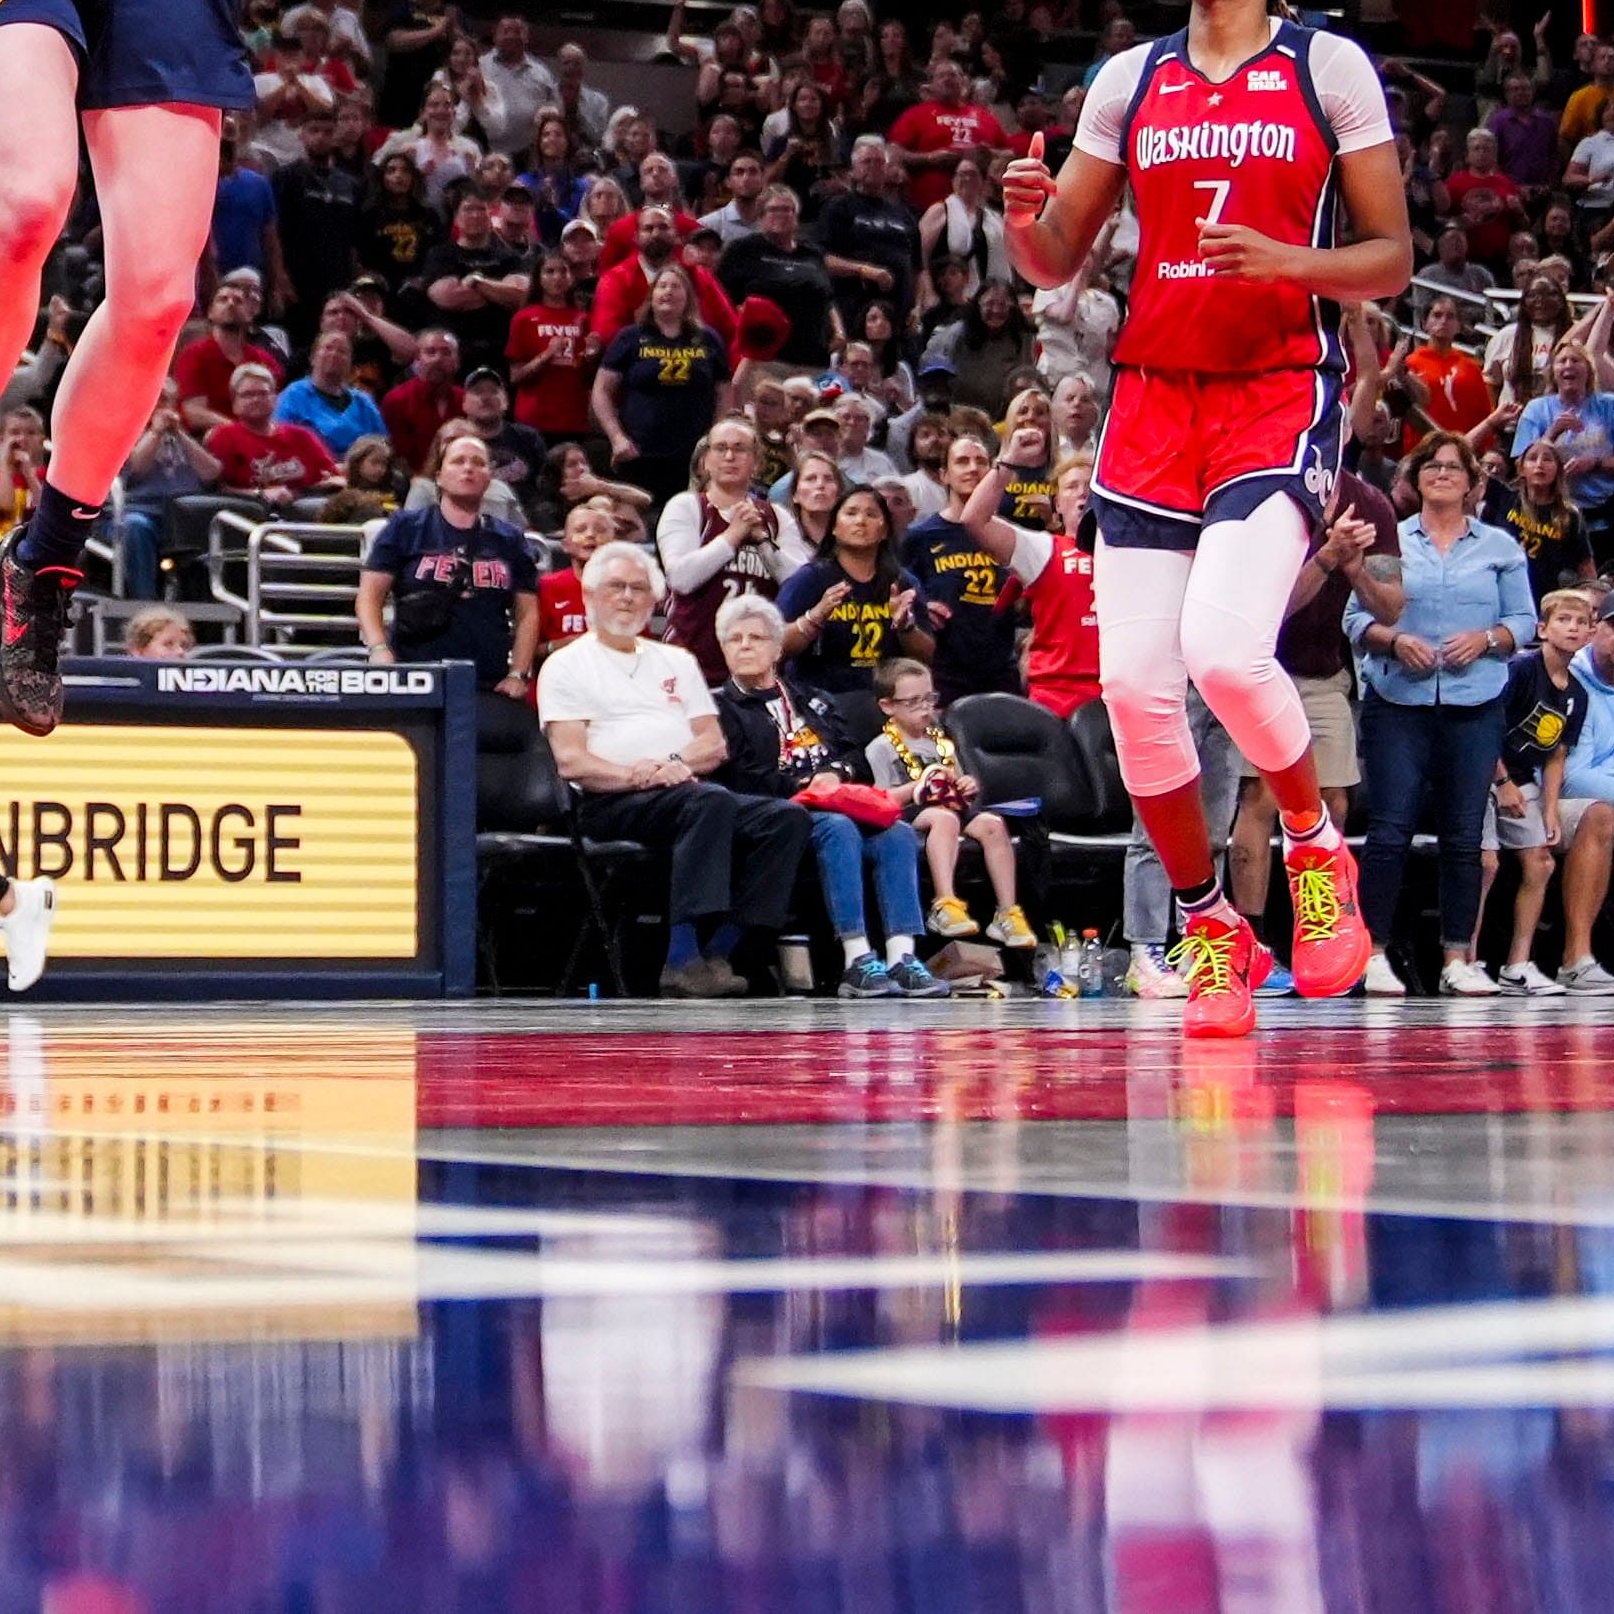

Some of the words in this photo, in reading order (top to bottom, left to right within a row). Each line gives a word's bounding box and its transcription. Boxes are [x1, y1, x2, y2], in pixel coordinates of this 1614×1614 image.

[1136, 121, 1296, 171] Washington
[1193, 180, 1231, 226] 7
[638, 345, 707, 360] INDIANA
[657, 359, 692, 383] 22
[416, 553, 510, 590] FEER
[963, 571, 995, 595] 22
[850, 621, 882, 659] 22
[157, 667, 305, 693] INDIANA
[305, 670, 340, 682] FOR
[340, 670, 435, 695] BOLD
